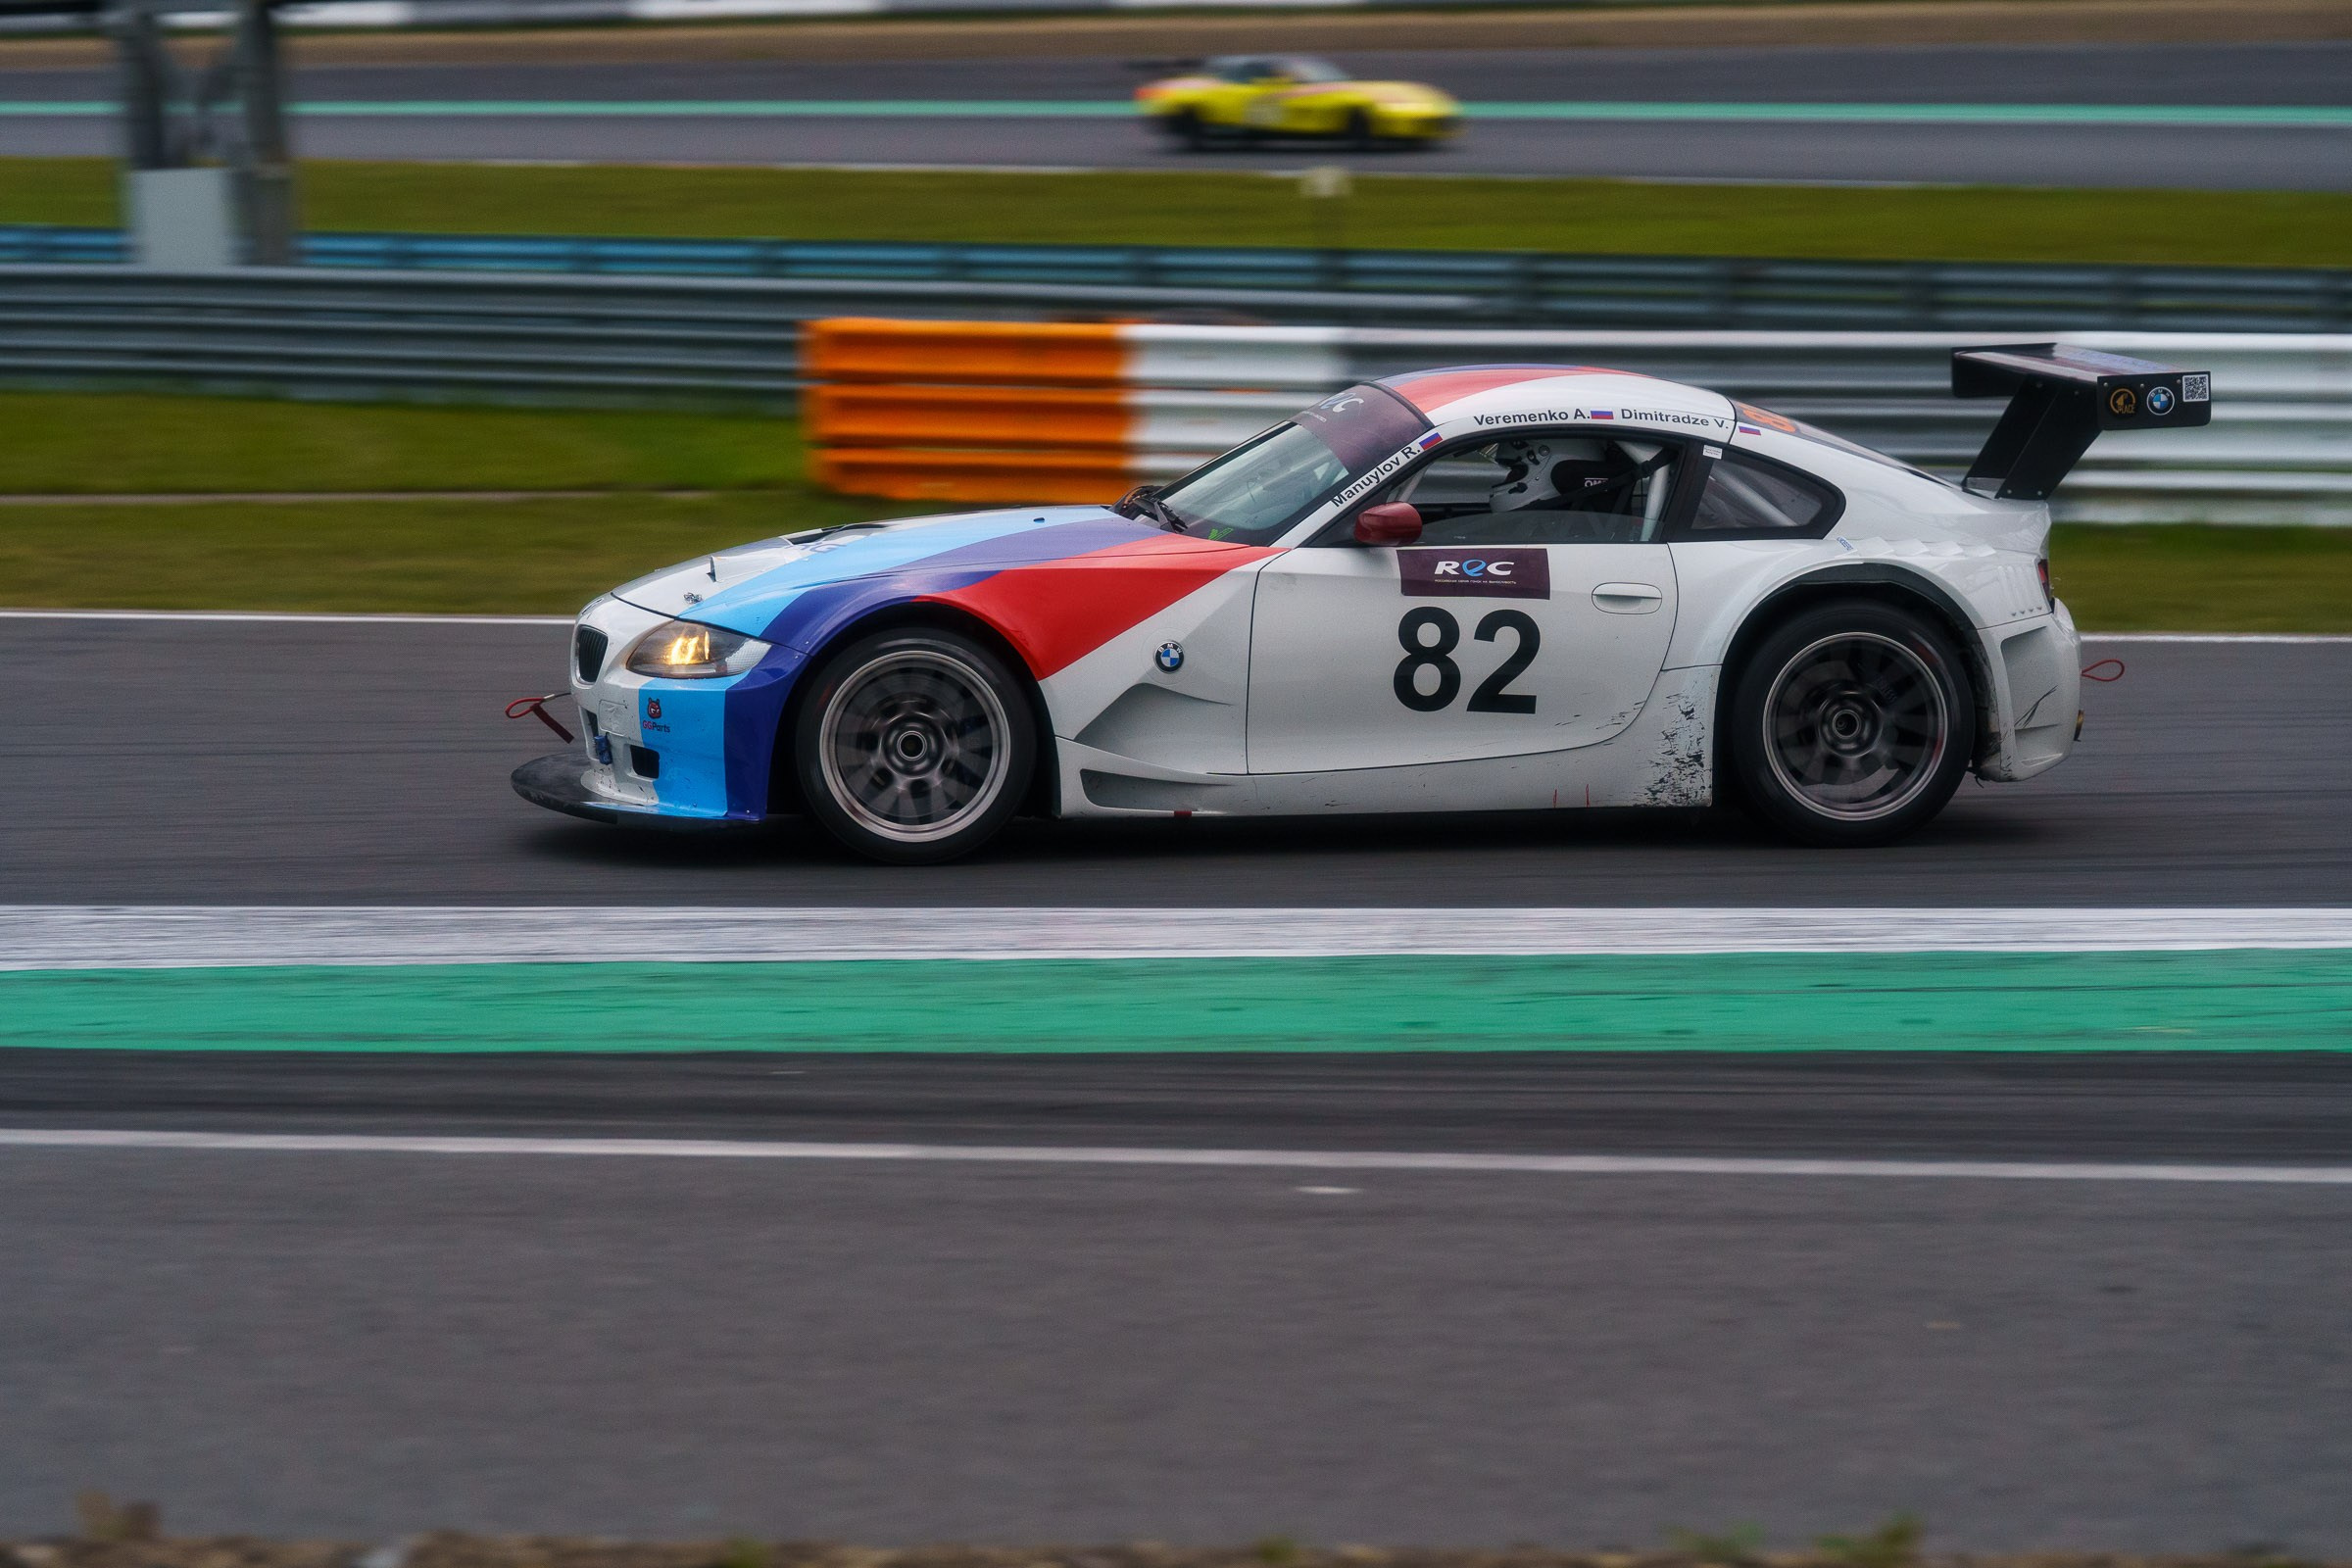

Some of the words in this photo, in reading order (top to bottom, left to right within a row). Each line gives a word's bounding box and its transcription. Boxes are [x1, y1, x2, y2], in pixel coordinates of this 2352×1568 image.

[1473, 409, 1569, 425] Veremenko
[1573, 408, 1591, 420] A.
[1621, 408, 1710, 426] Dimitradze
[1713, 418, 1730, 429] V.
[1331, 457, 1400, 507] Manuylov
[1400, 446, 1421, 460] R.
[1394, 606, 1541, 714] 82
[642, 720, 671, 733] GGParts
